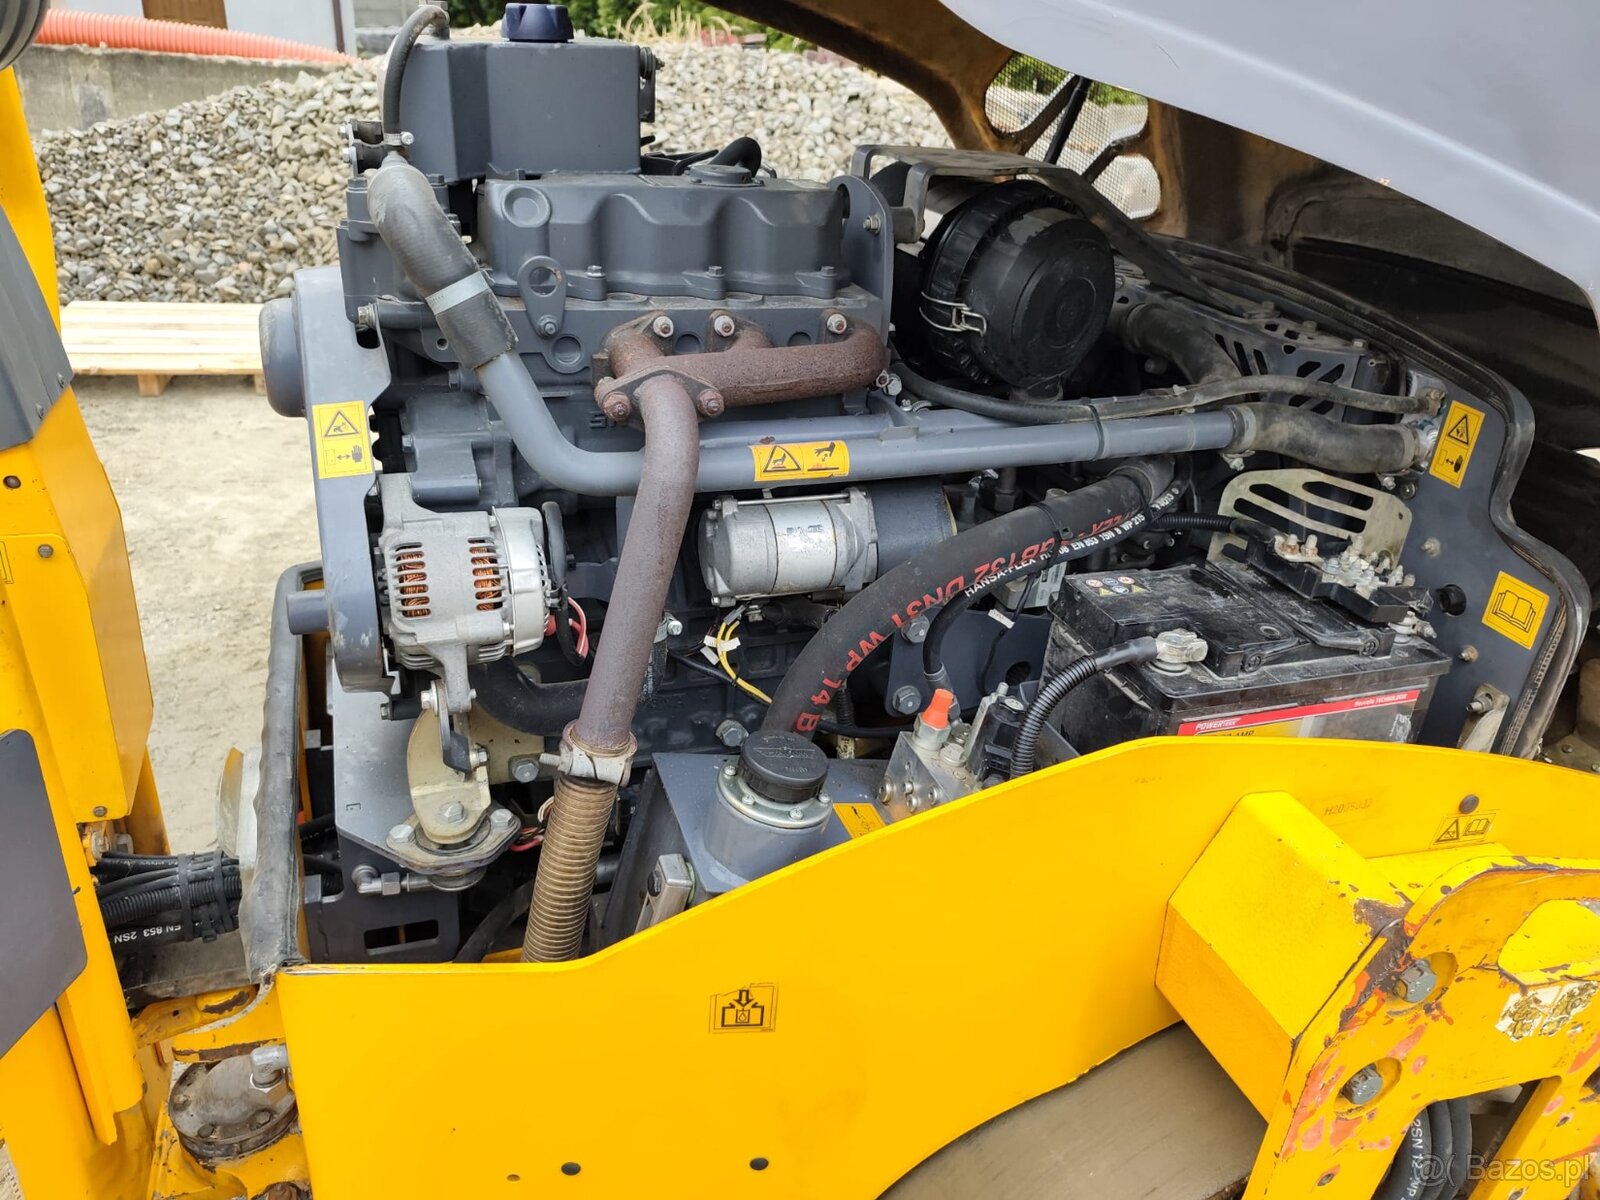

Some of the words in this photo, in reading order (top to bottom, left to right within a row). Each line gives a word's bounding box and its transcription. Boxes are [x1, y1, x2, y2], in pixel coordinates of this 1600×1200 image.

[964, 559, 1036, 597] HANSA-FLEX
[1071, 540, 1085, 551] EN
[1085, 536, 1099, 547] 853
[1099, 530, 1115, 542] 1SN
[1121, 519, 1134, 532] WP
[846, 631, 885, 672] WP
[811, 677, 843, 705] 14
[794, 712, 820, 734] B
[114, 931, 137, 944] 2SN
[143, 926, 163, 937] 853
[1411, 1118, 1424, 1149] 2SN
